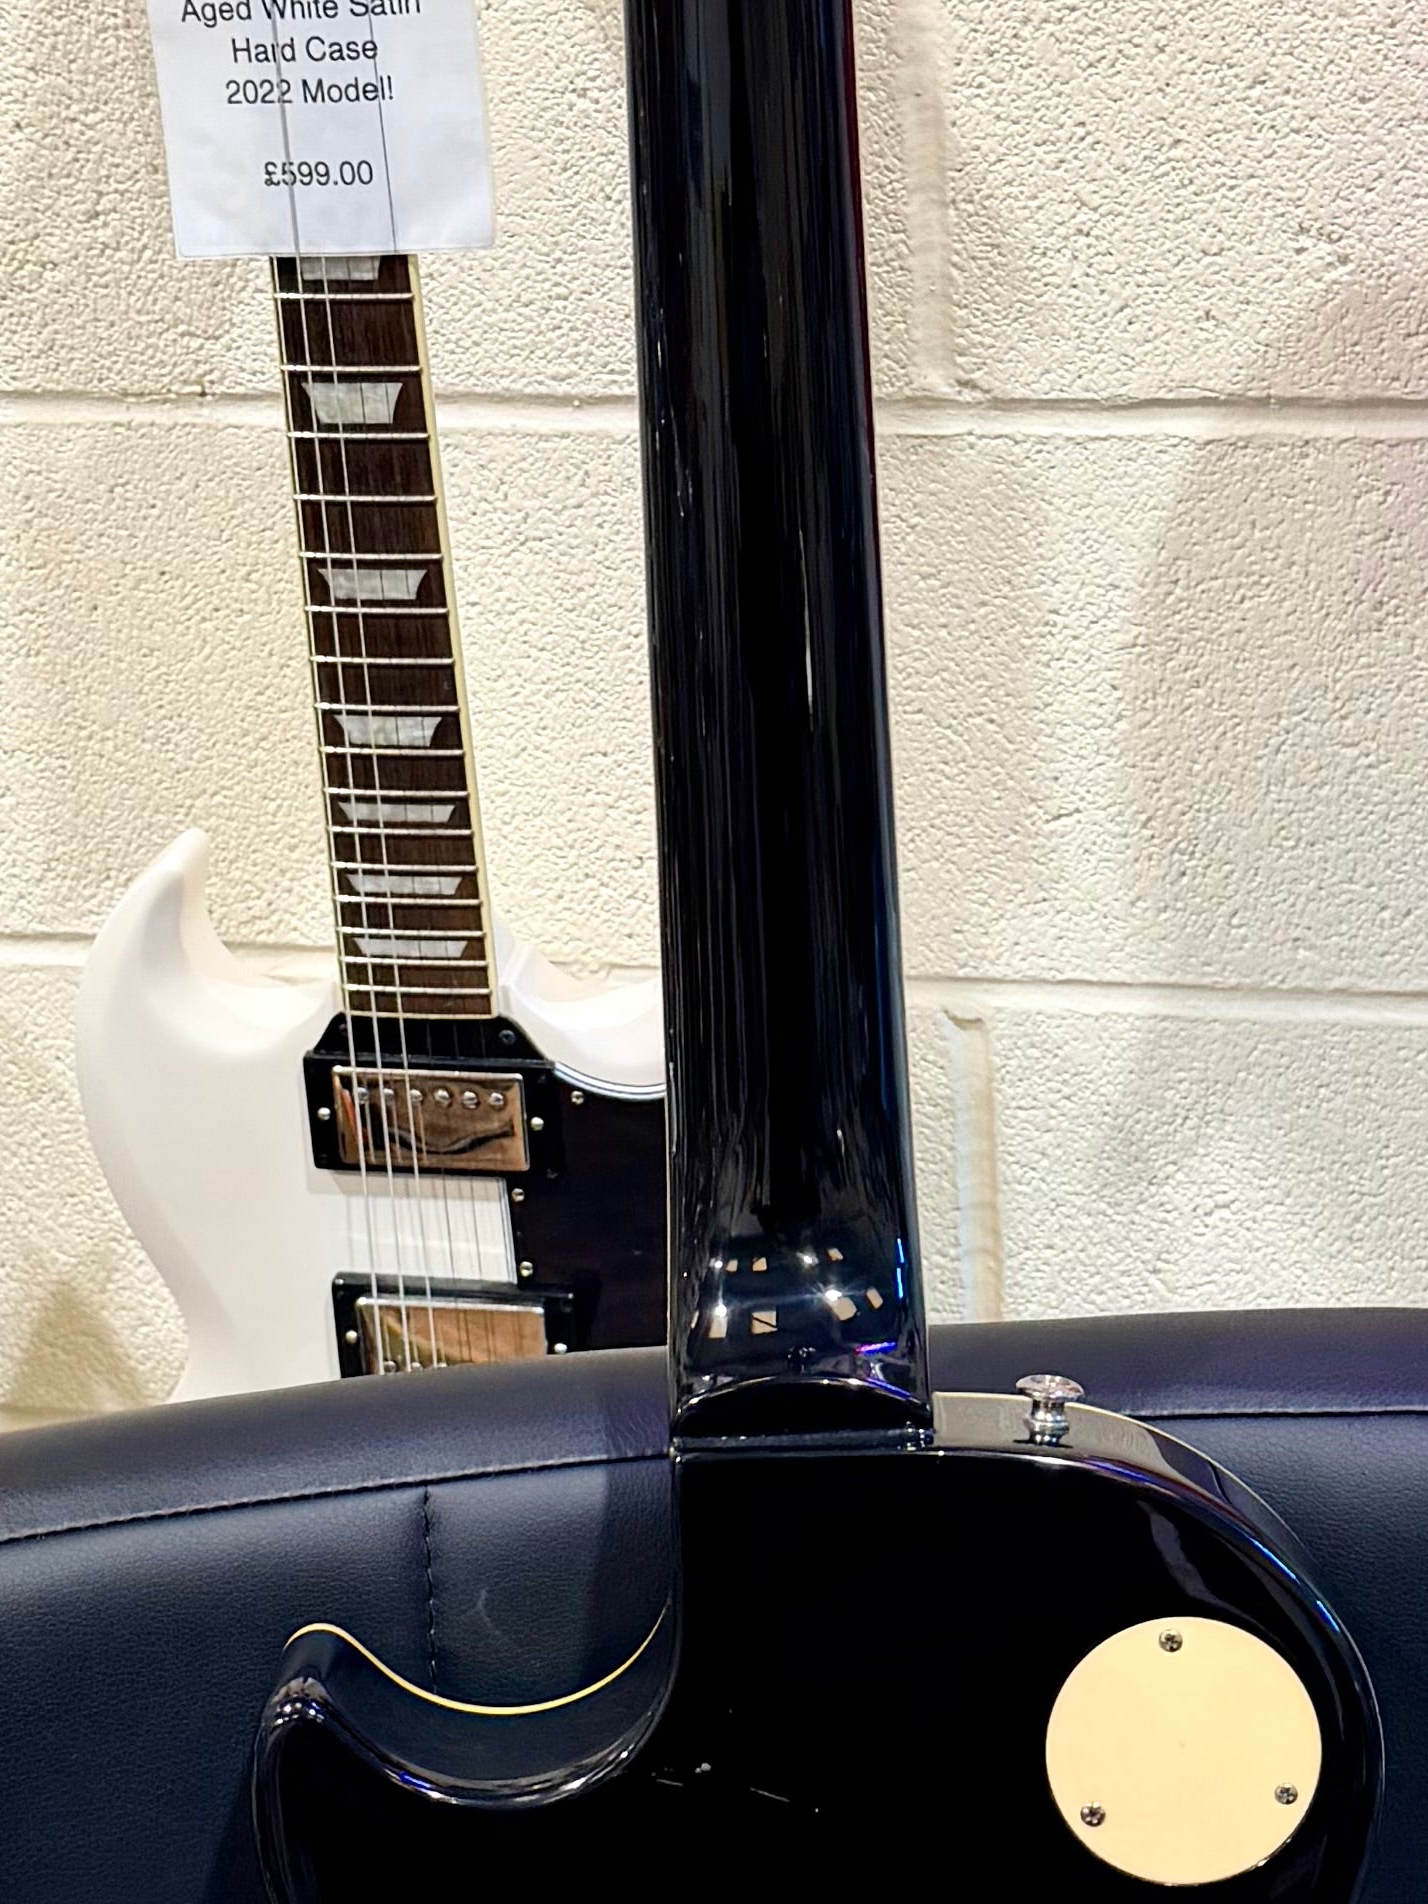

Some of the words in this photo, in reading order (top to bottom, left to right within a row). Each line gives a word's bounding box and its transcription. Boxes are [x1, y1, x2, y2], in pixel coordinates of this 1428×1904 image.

[232, 37, 295, 63] Hard
[307, 36, 378, 60] Case
[226, 80, 293, 104] 2022
[303, 76, 393, 102] Model!
[264, 160, 373, 187] £599.00
